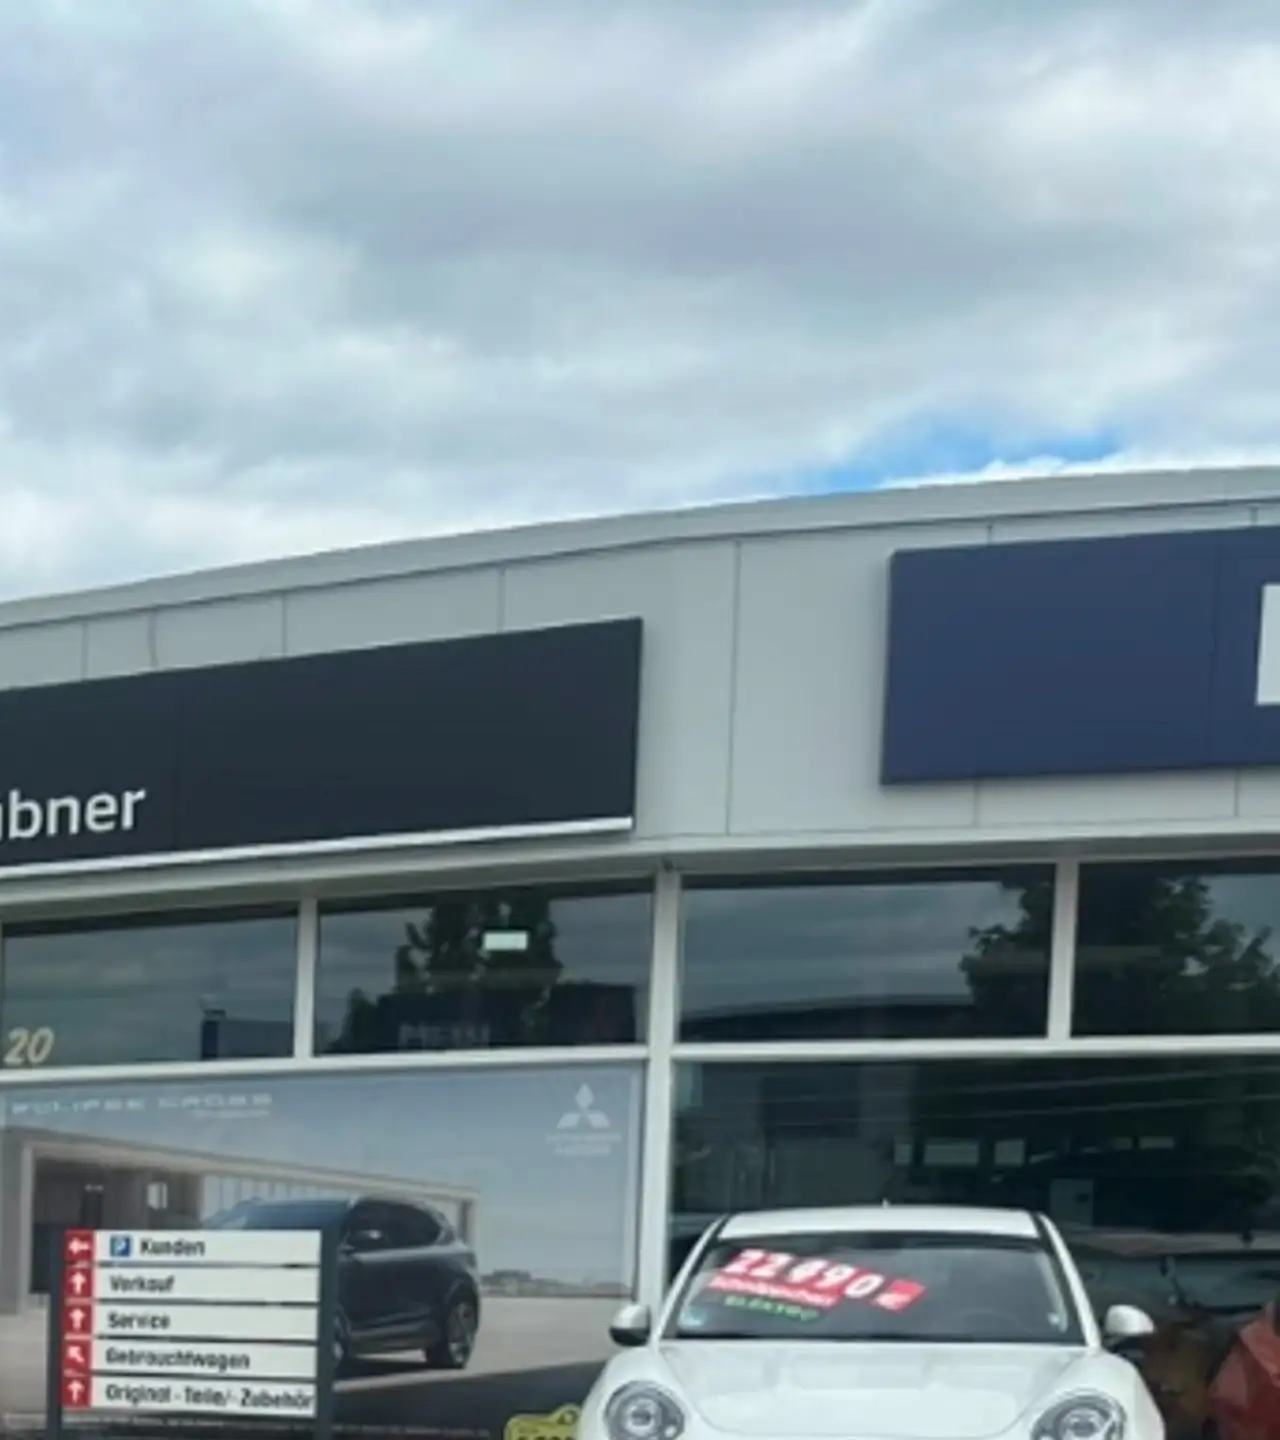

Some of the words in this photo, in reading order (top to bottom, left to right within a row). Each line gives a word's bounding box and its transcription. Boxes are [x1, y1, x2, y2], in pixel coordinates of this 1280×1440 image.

[2, 1026, 55, 1067] 20
[140, 1238, 206, 1256] Kunden
[109, 1275, 175, 1293] Verkauf
[107, 1312, 171, 1330] Service
[104, 1347, 251, 1372] Gebrauchtwagen
